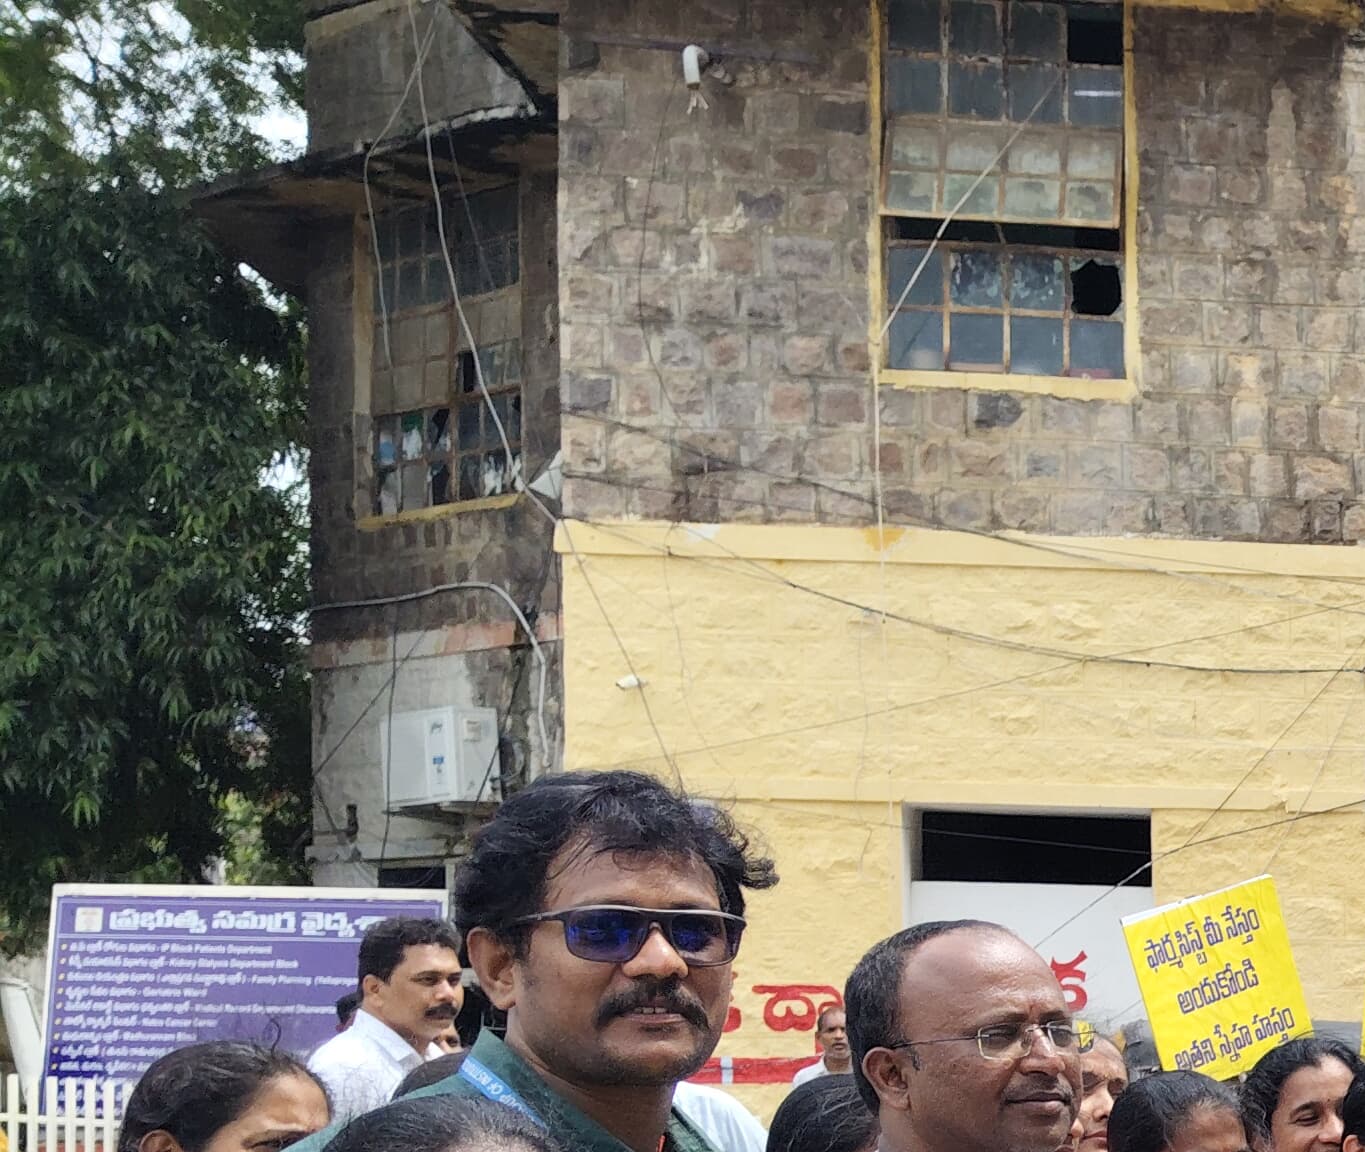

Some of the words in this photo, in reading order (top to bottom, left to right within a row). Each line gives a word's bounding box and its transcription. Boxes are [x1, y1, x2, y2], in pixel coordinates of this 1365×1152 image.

[109, 908, 208, 934] ప్రభుత్వ
[211, 909, 297, 933] సమగ్ర
[1203, 915, 1224, 946] మీ
